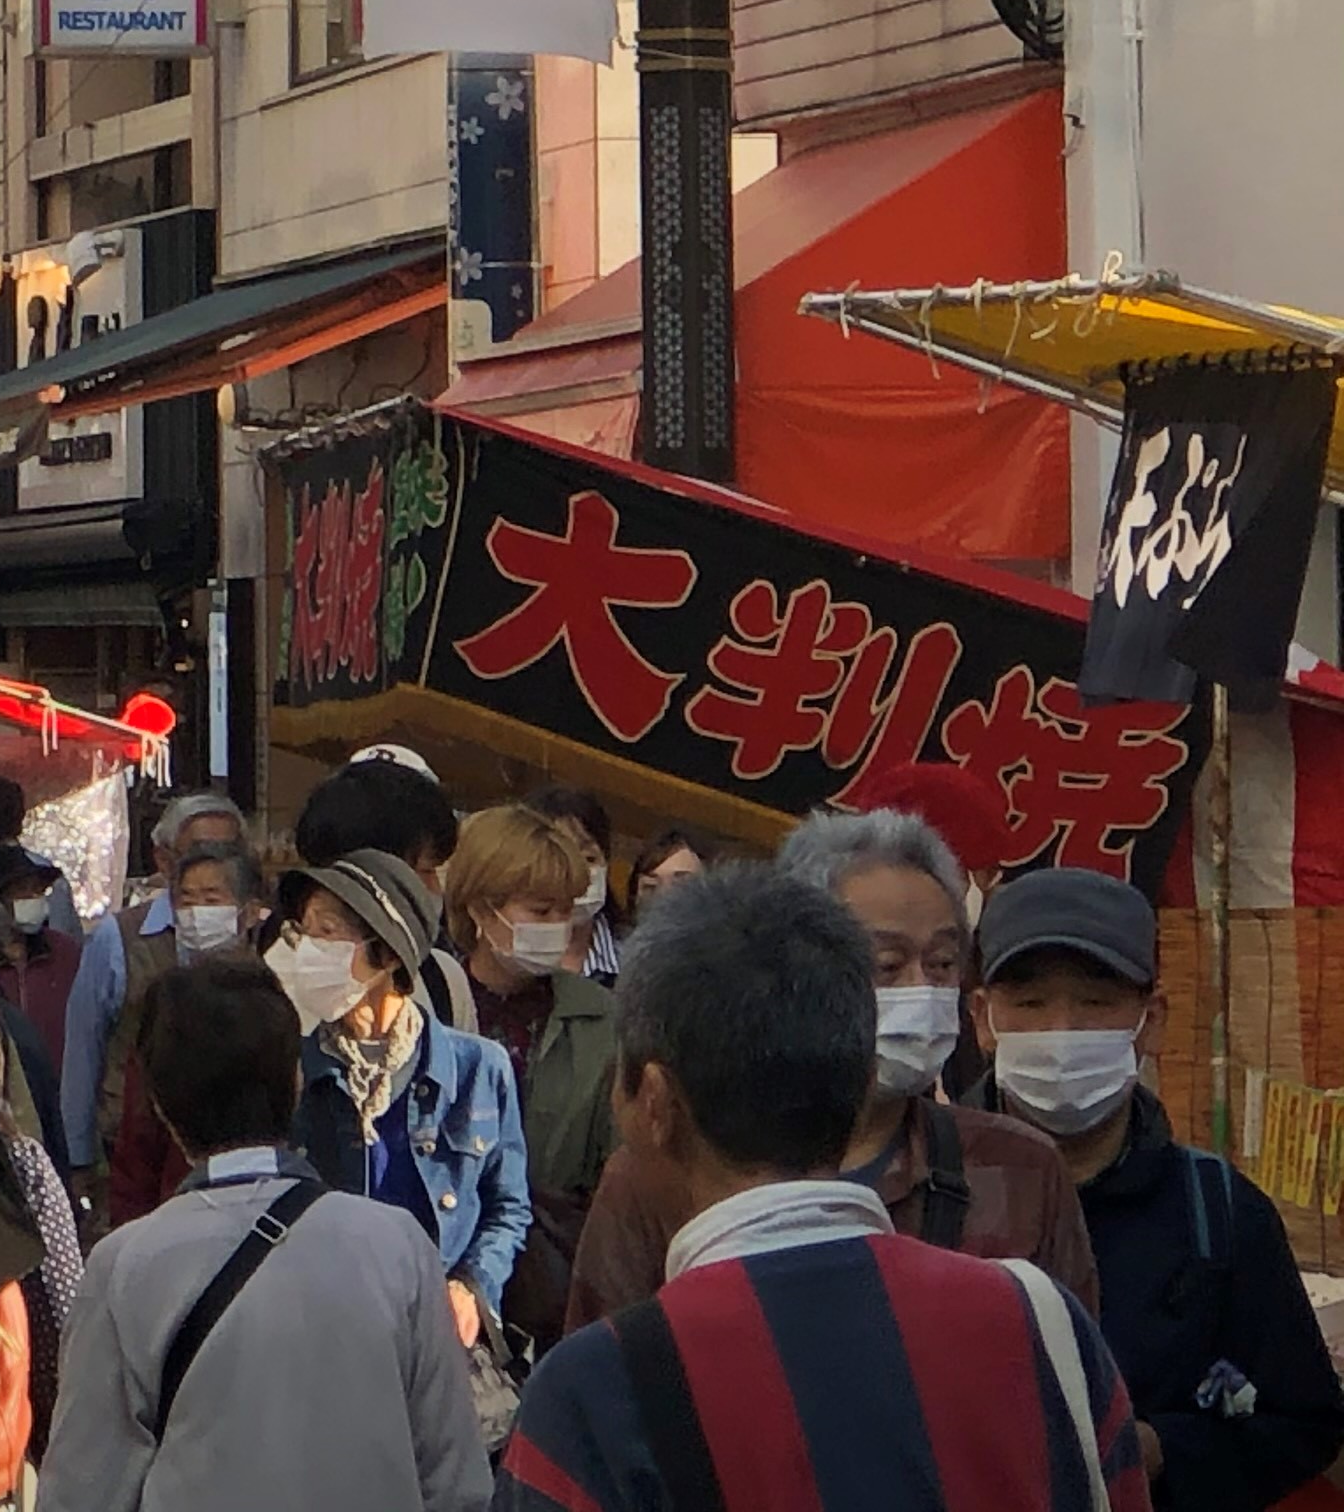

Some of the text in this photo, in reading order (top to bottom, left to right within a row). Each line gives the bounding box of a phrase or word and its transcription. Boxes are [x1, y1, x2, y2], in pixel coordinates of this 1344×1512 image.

[57, 8, 187, 34] RESTAURANT
[453, 490, 1191, 882] 大判焼
